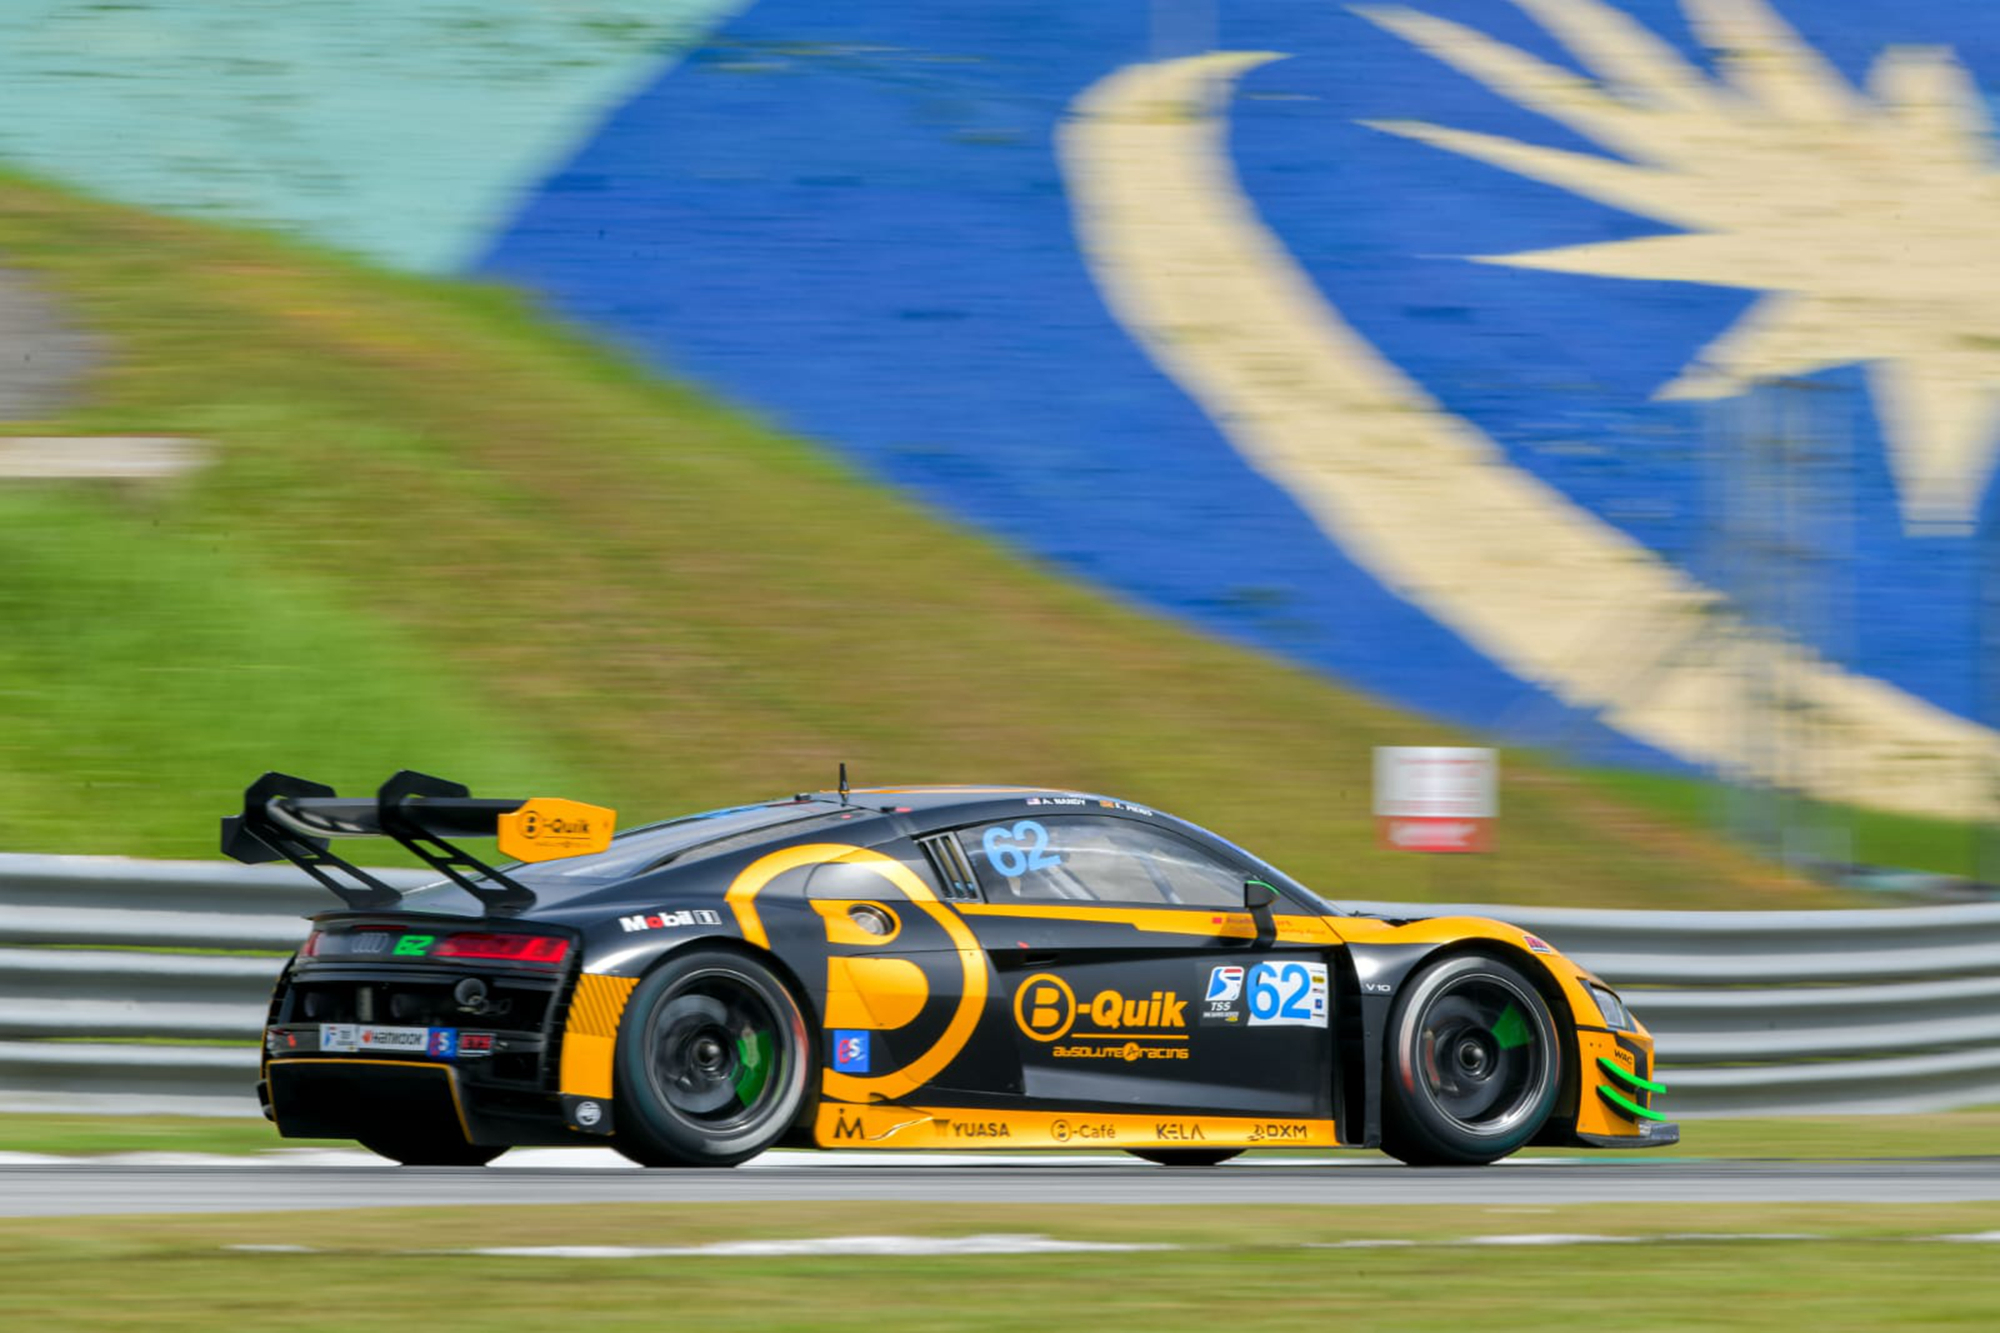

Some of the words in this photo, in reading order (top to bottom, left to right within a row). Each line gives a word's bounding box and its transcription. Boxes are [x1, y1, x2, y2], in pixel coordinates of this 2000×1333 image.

[983, 820, 1062, 877] 62
[619, 910, 695, 932] Mobil
[393, 935, 434, 956] 62
[1246, 963, 1311, 1020] 62
[1365, 983, 1391, 992] V10
[1210, 1002, 1231, 1011] TSS
[1614, 1049, 1633, 1066] WAC
[952, 1122, 1011, 1137] YUASA
[1155, 1123, 1206, 1141] KELA
